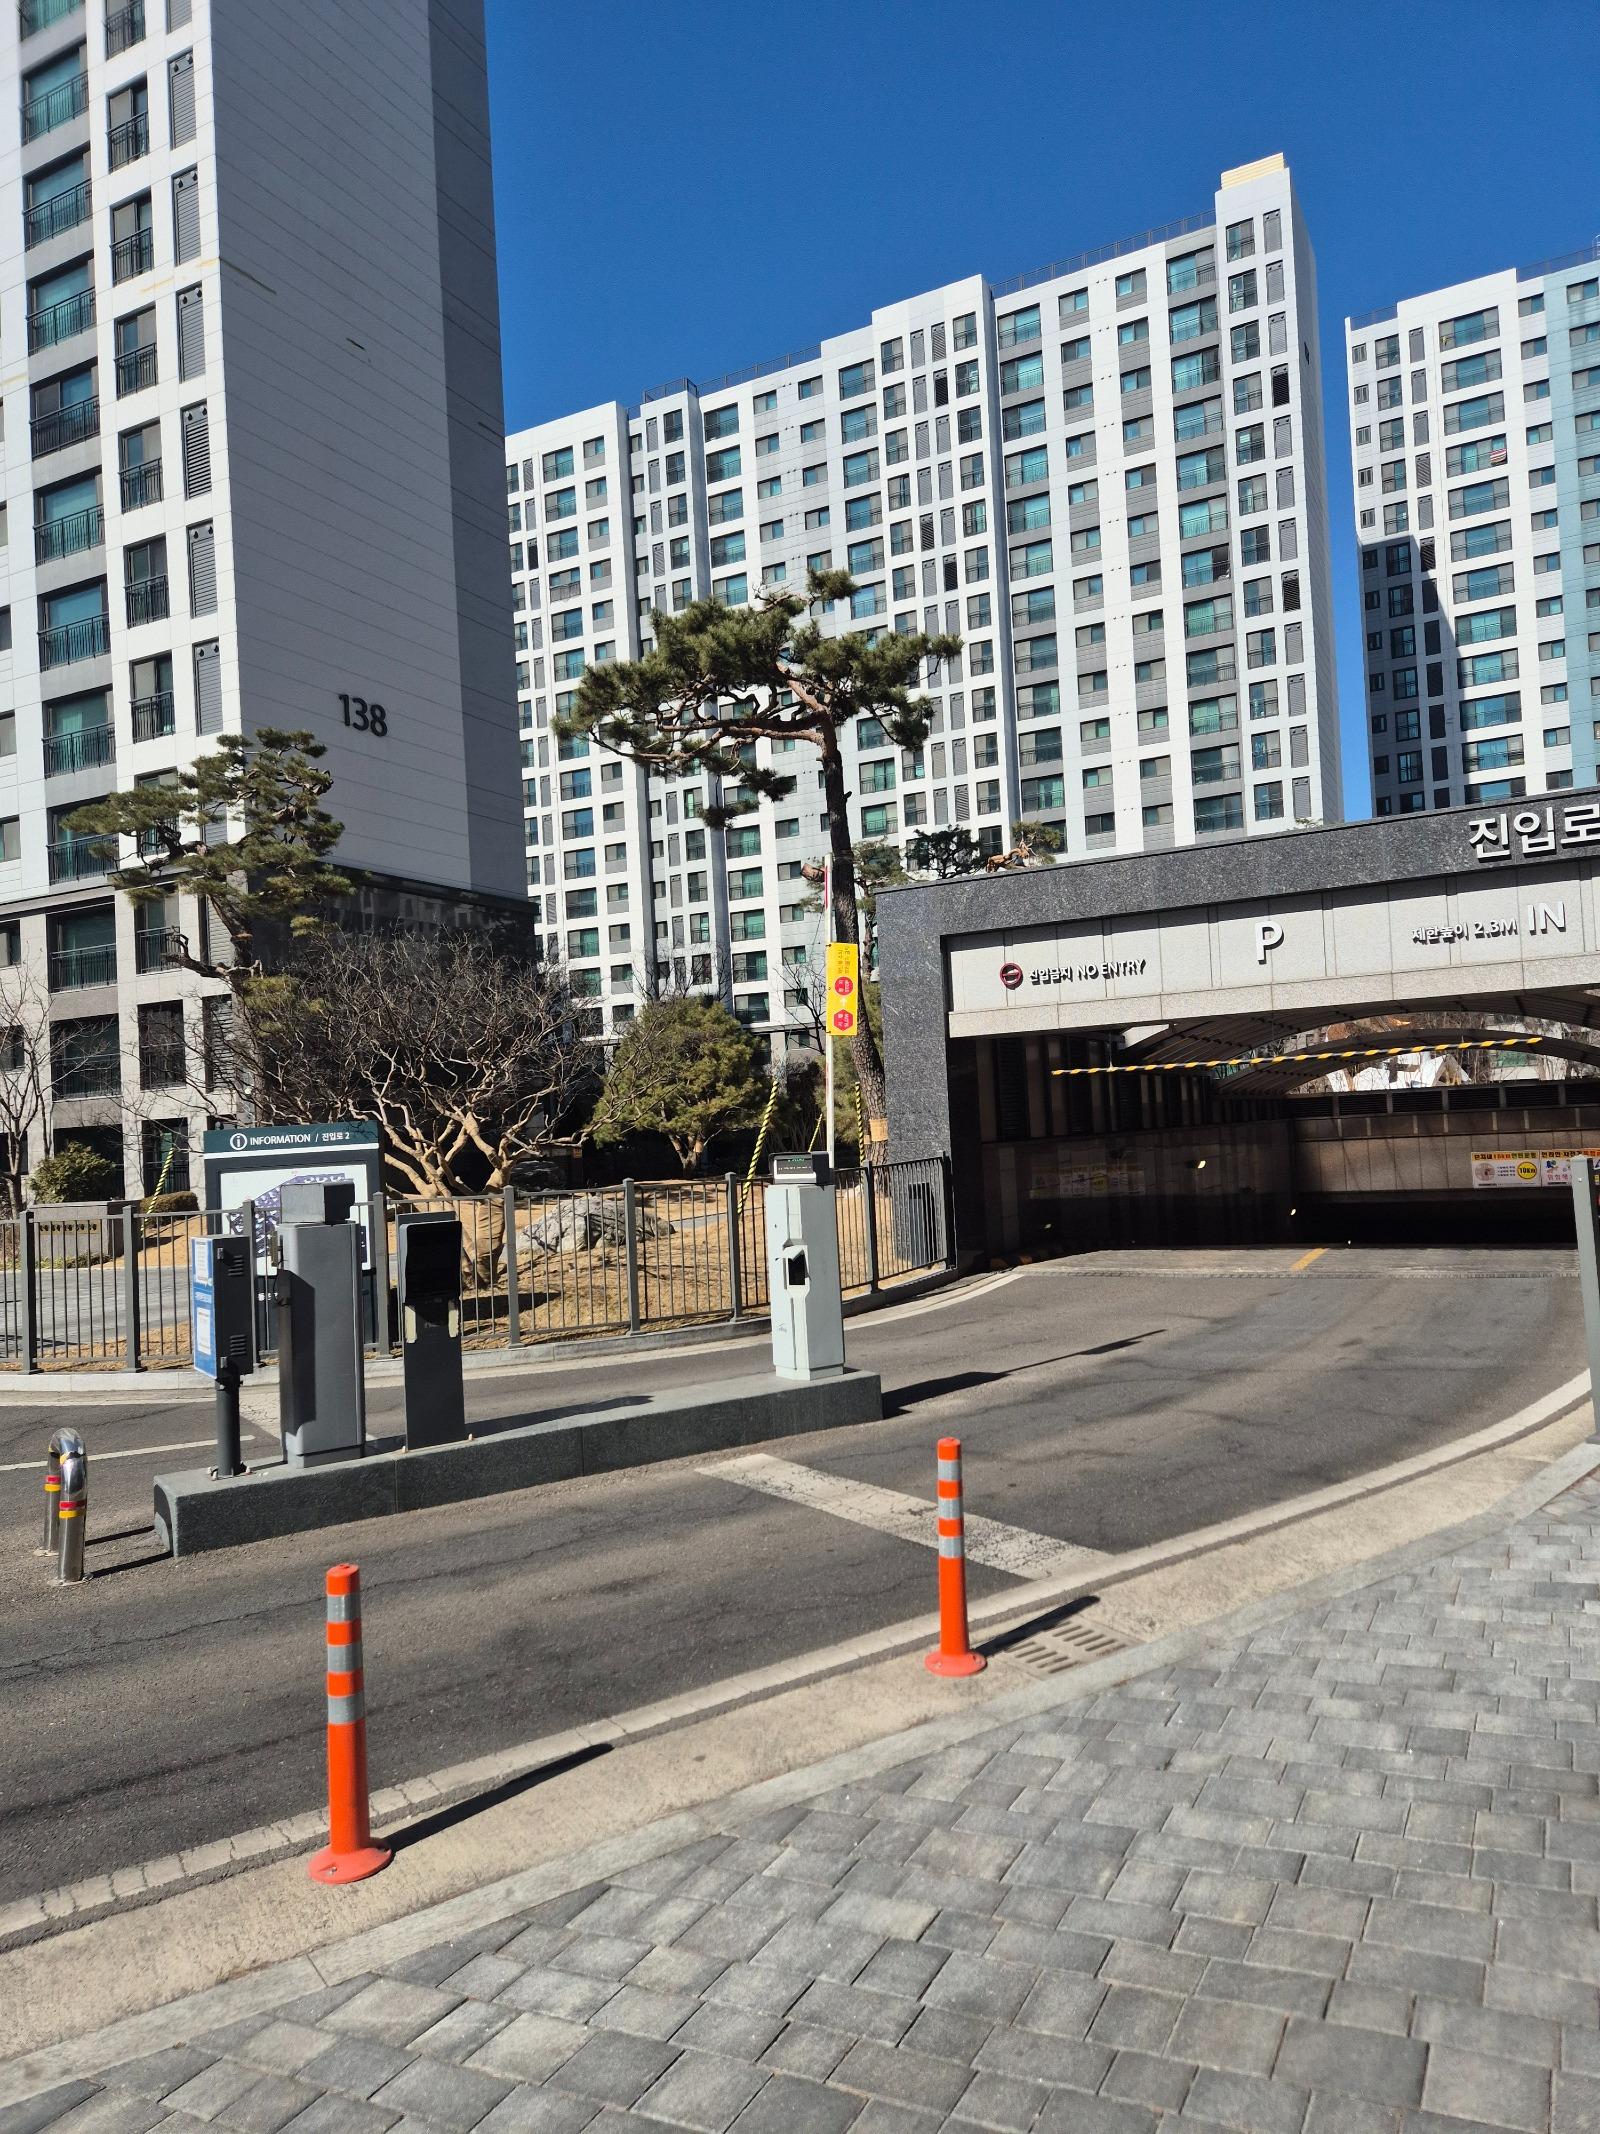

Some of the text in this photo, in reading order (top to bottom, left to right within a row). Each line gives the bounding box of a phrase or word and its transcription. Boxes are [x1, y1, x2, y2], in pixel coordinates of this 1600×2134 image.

[338, 694, 388, 738] 138
[1468, 803, 1600, 861] 진입로
[1411, 918, 1518, 942] 제한높이 2.3M
[1527, 901, 1566, 934] IN
[1255, 920, 1284, 964] P
[1029, 959, 1146, 984] 진입금지 NO ENTRY
[250, 1133, 311, 1146] INFORMATION
[321, 1132, 343, 1142] 진입로
[345, 1131, 350, 1140] 2
